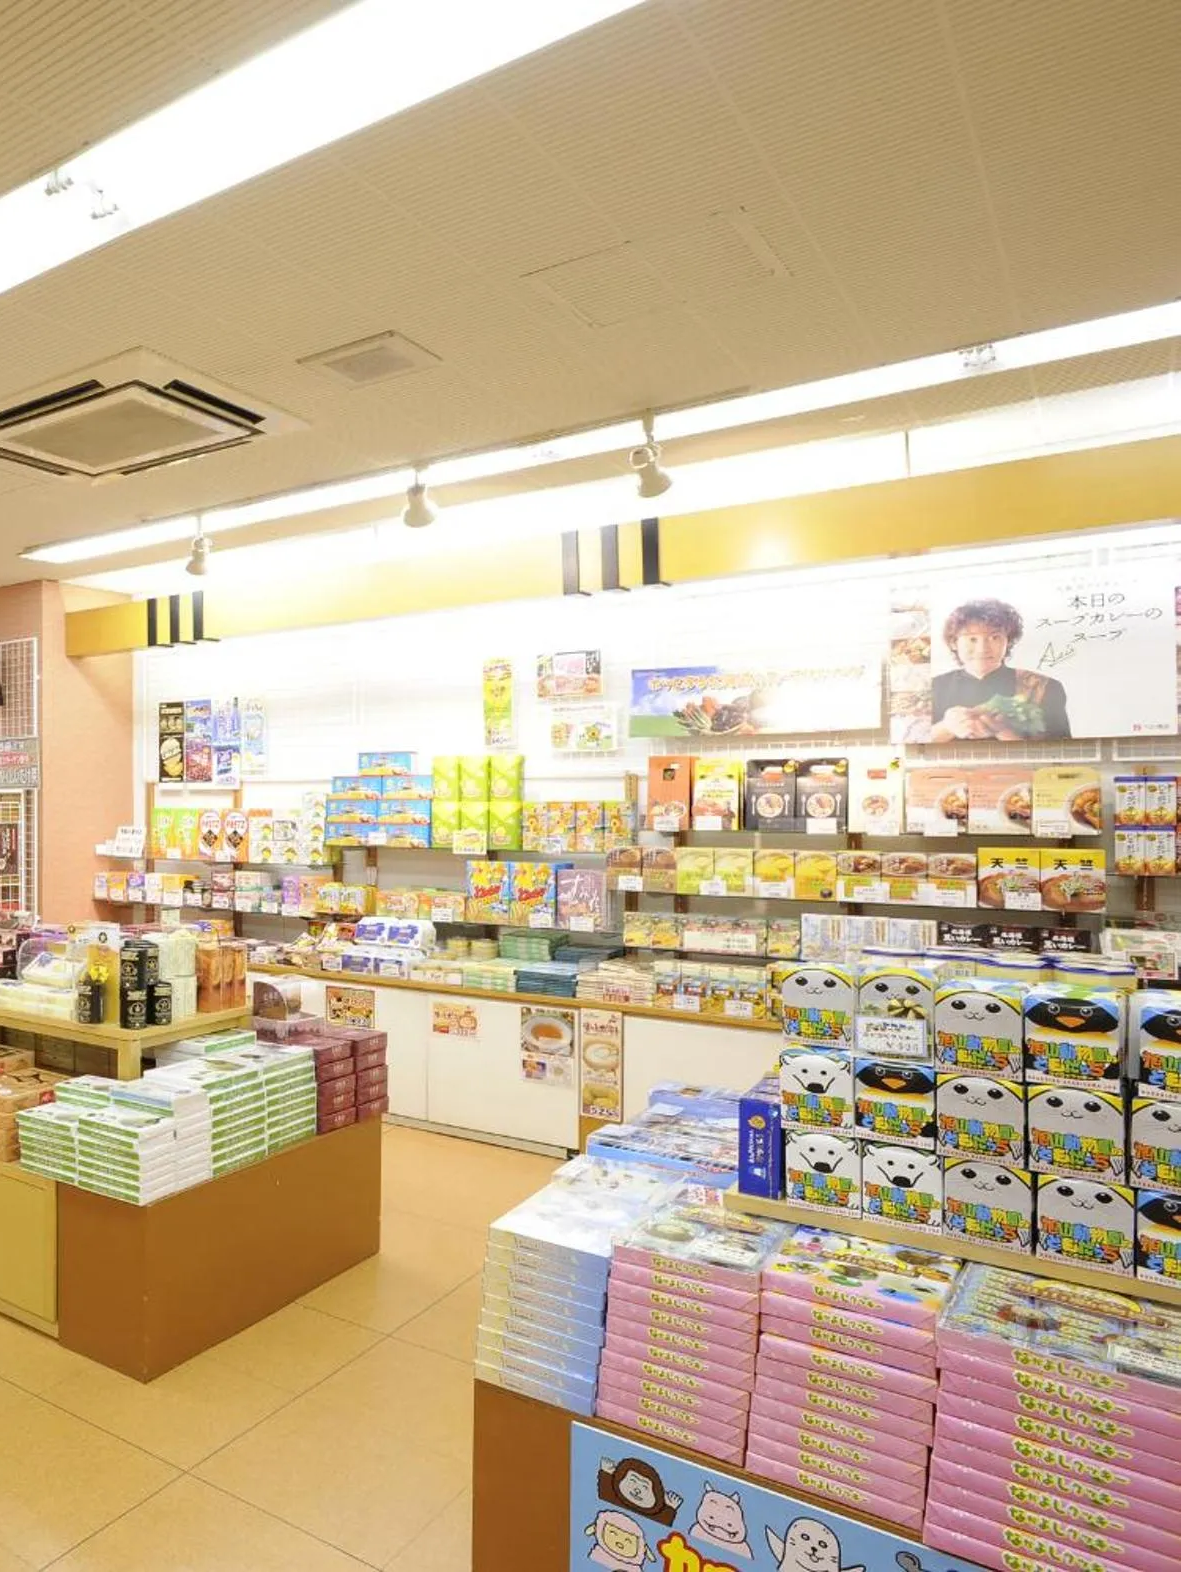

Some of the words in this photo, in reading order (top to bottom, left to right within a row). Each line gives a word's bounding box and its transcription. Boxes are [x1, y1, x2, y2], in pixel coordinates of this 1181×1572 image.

[1036, 607, 1163, 629] スープカレーの
[1068, 593, 1125, 609] 本日の
[1073, 629, 1125, 642] スープ
[1013, 1349, 1128, 1389] なかよしクッキー
[1013, 1370, 1130, 1414] なかよしクッキー
[1018, 1392, 1135, 1437] なかよしクッキー
[1016, 1415, 1133, 1459] なかよしクッキー
[1013, 1438, 1131, 1484] なかよしクッキー
[1007, 1482, 1124, 1531] なかよしクッキー
[1012, 1461, 1129, 1508] なかよしクッキー
[1006, 1504, 1124, 1553] なかよしクッキー
